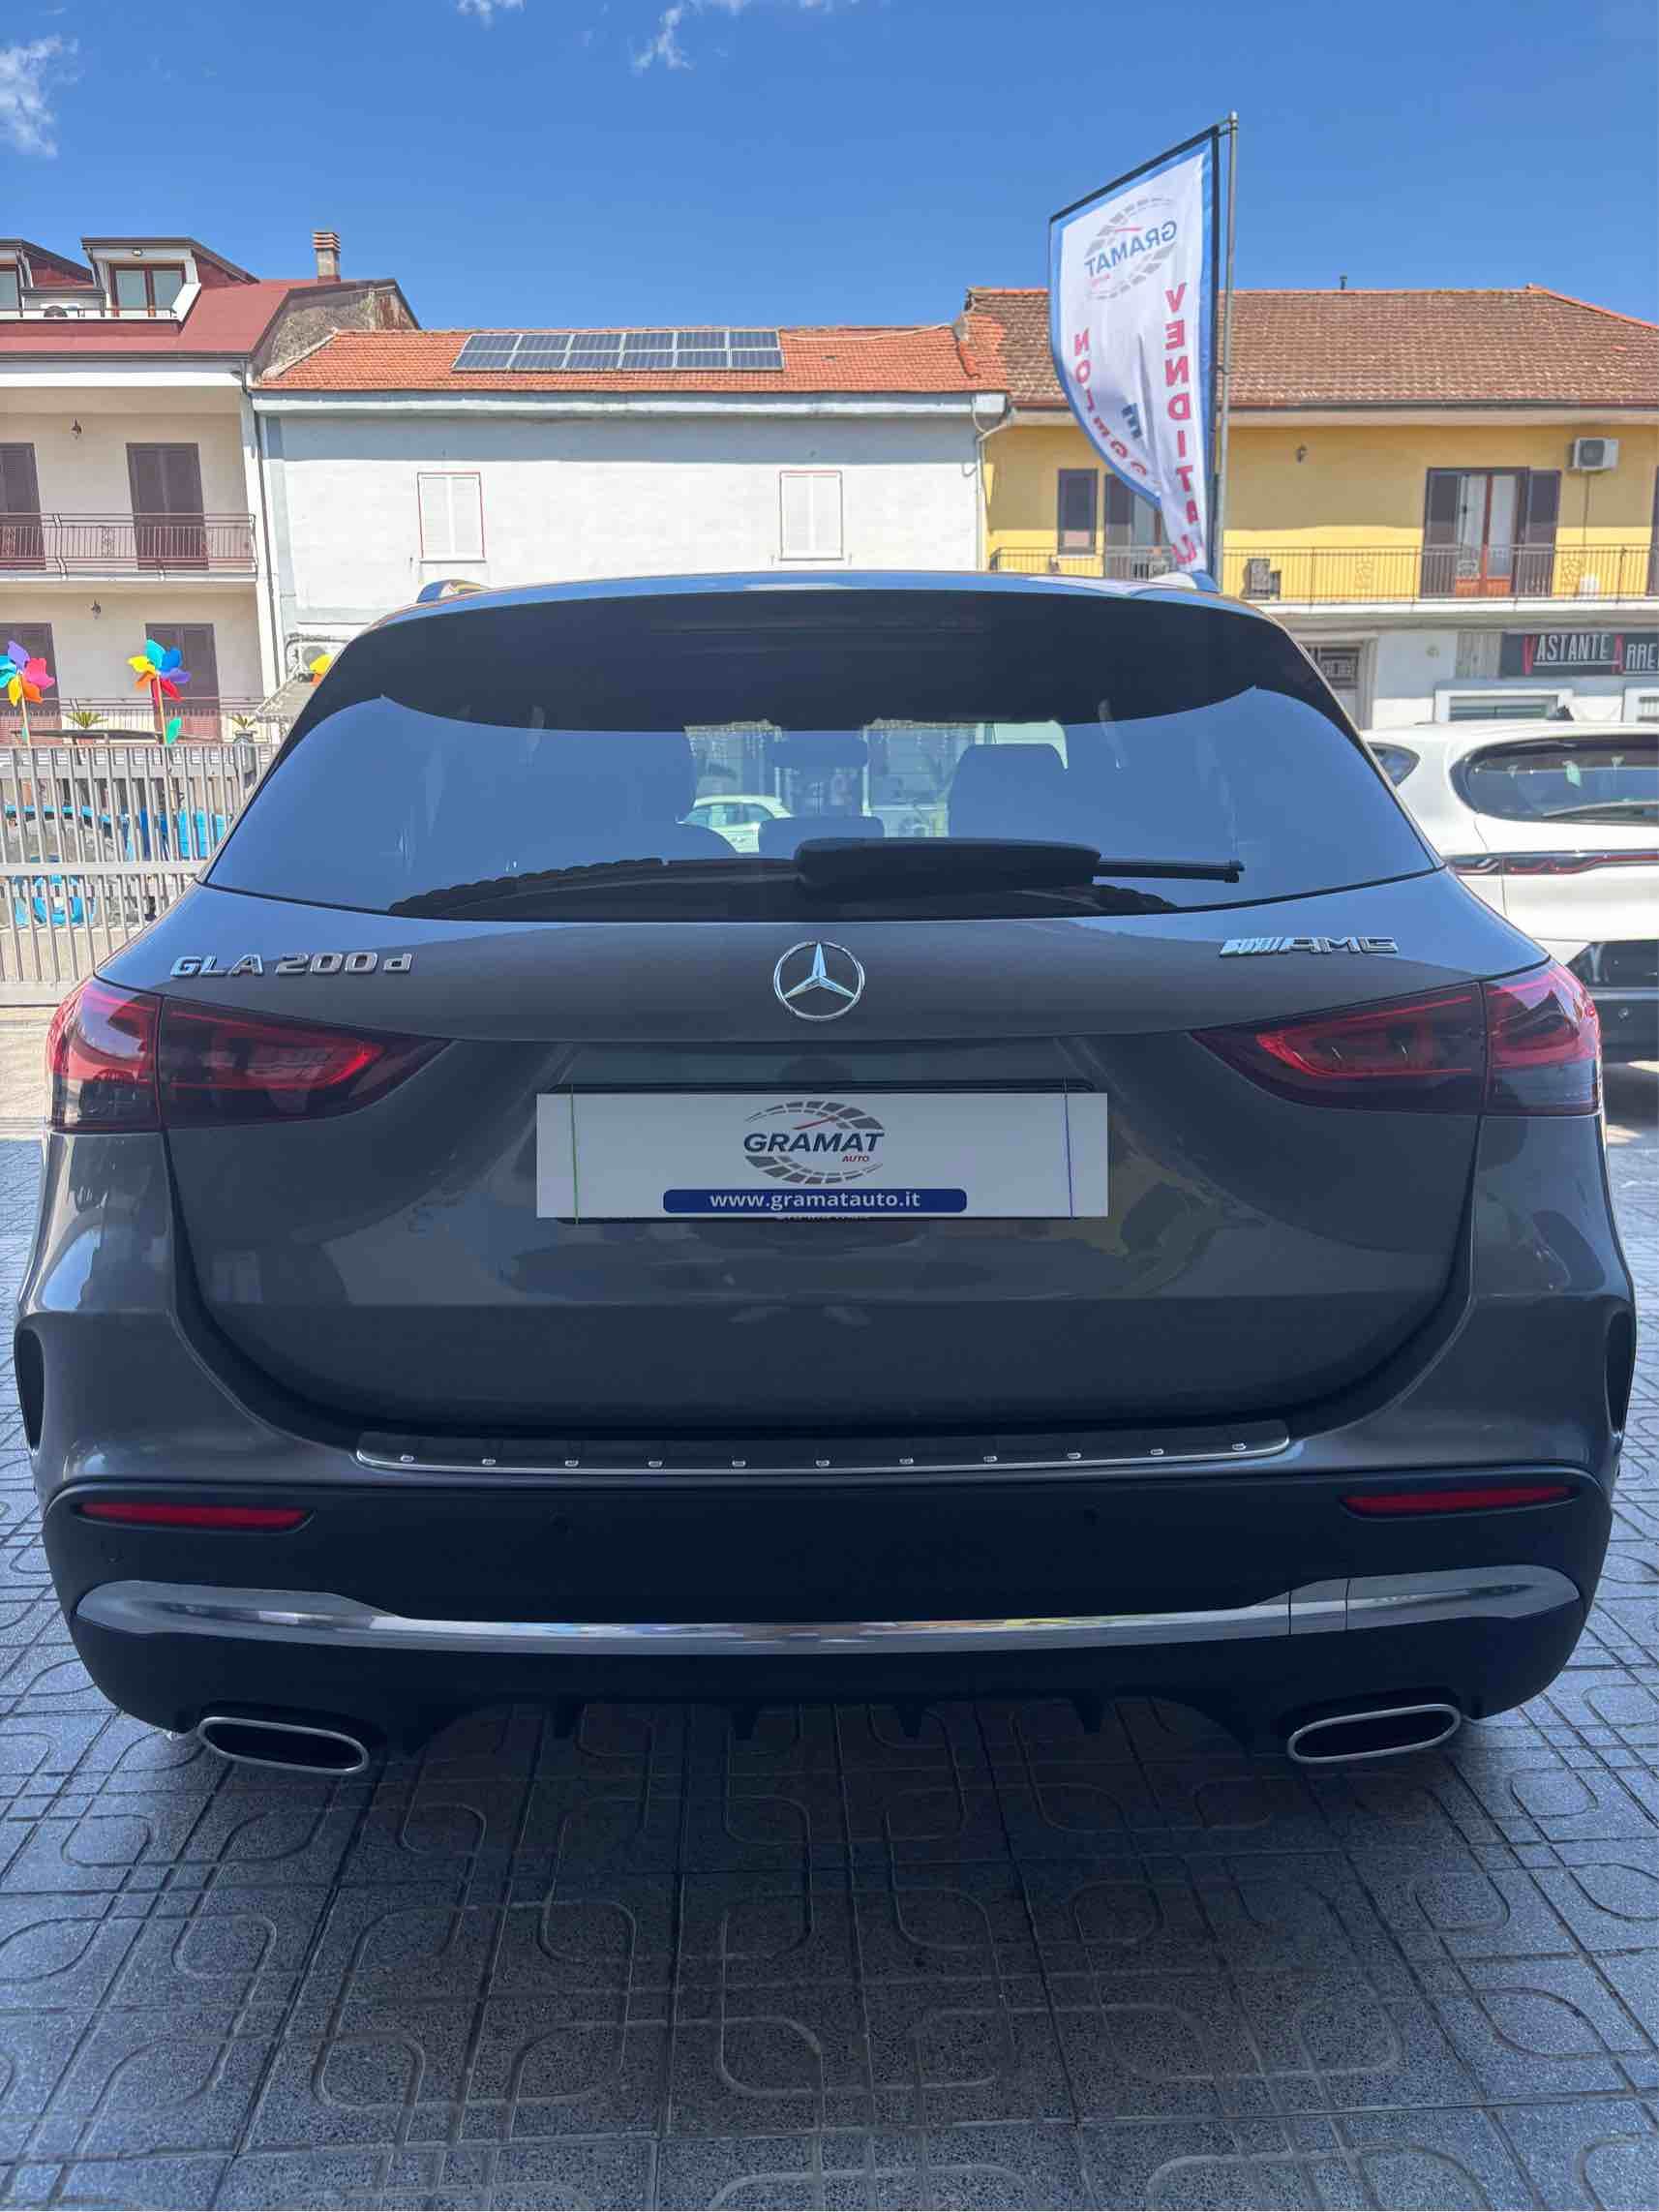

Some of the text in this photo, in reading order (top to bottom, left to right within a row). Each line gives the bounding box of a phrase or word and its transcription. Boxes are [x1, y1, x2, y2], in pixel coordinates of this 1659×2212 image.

[1523, 634, 1659, 675] VASTANTE ARRE
[170, 953, 264, 977] GLA
[743, 1132, 885, 1153] GRAMAT
[841, 1154, 869, 1163] AUTO
[709, 1191, 920, 1210] www.gramatauto.it
